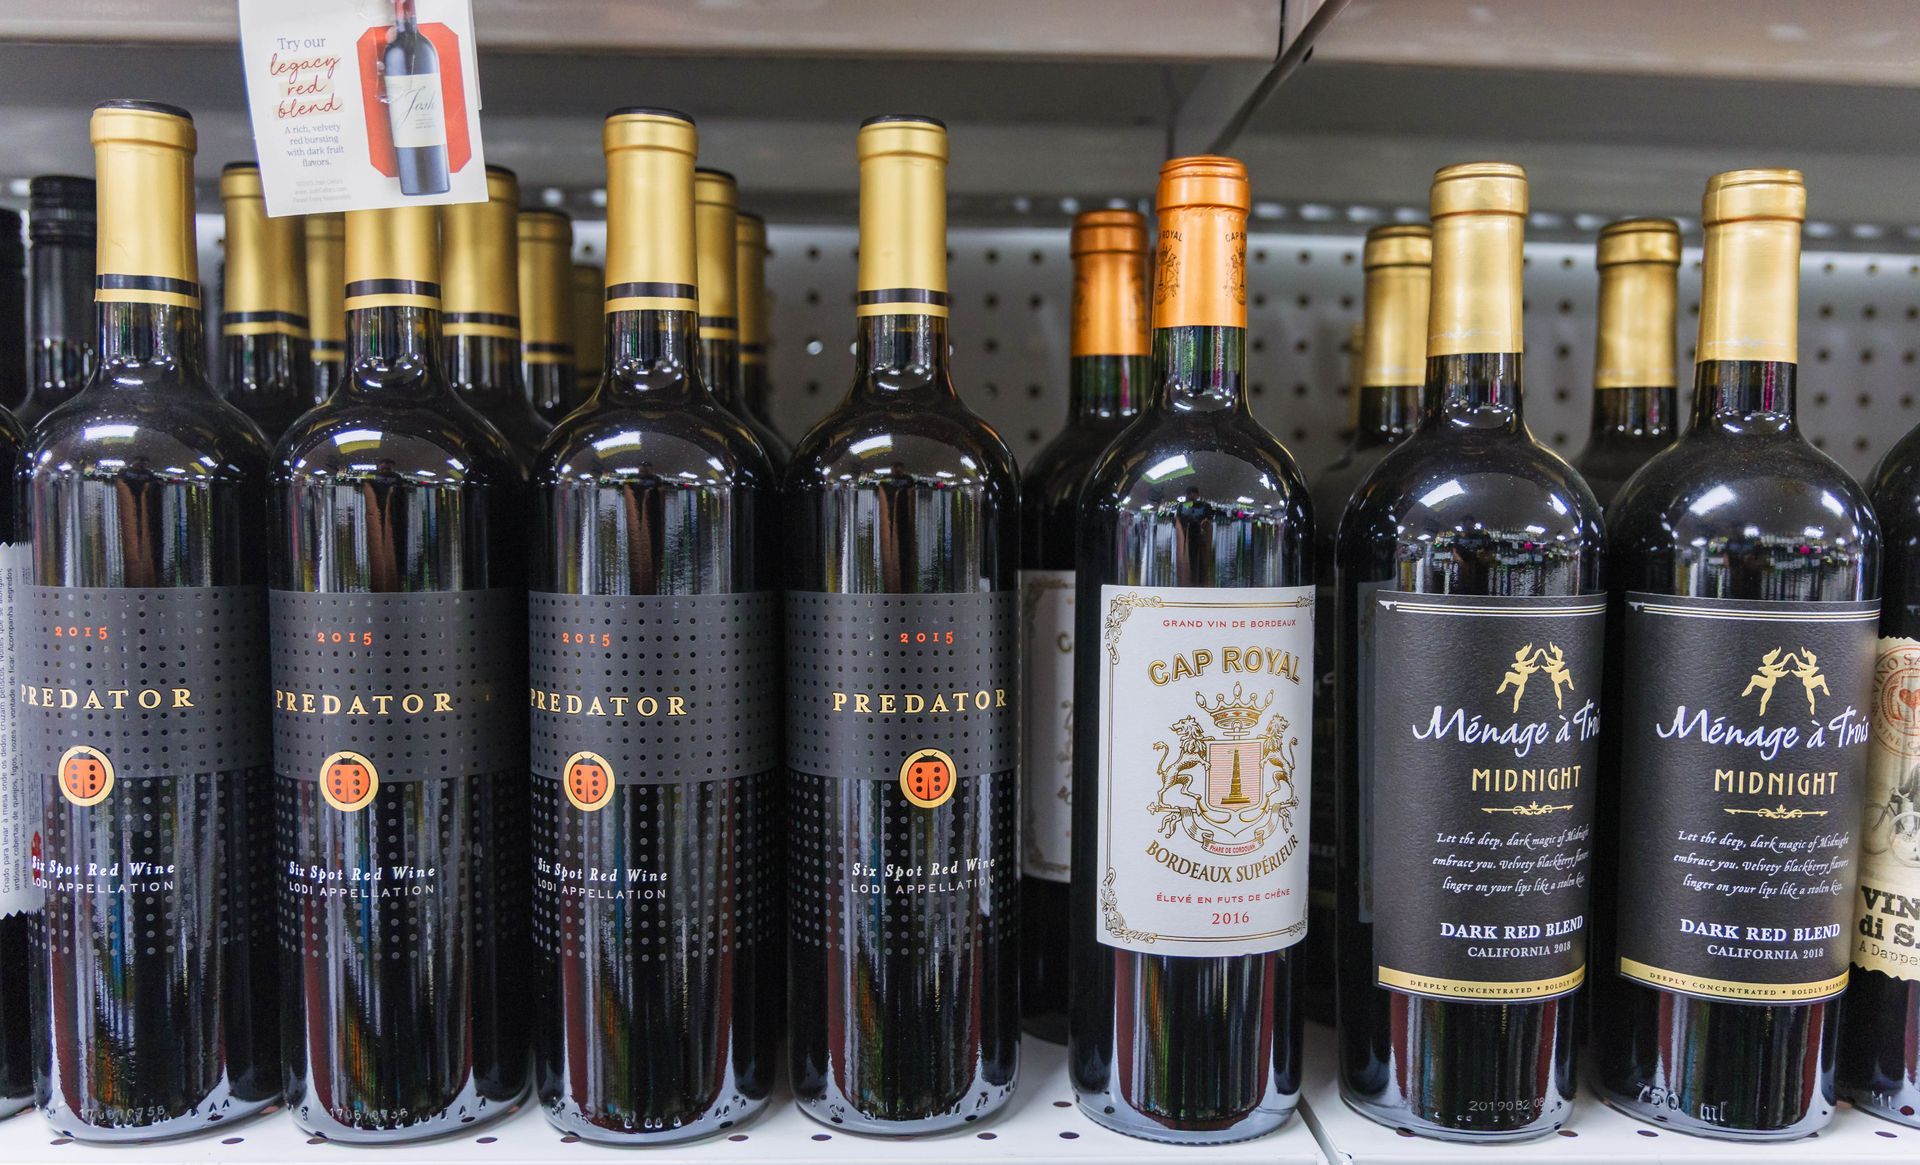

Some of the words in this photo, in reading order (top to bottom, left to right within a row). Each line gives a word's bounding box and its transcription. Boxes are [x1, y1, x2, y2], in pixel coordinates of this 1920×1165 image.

[277, 38, 300, 52] Try
[304, 38, 326, 49] our
[270, 53, 342, 84] legacy
[288, 74, 327, 96] red
[278, 93, 343, 118] blend
[284, 126, 291, 135] A
[293, 125, 311, 134] rich,
[312, 123, 341, 134] velvety
[290, 137, 303, 145] red
[305, 135, 339, 146] bursting
[287, 148, 305, 157] with
[307, 147, 325, 156] dark
[326, 146, 344, 154] fruit
[302, 159, 331, 167] flavors.
[6, 567, 15, 603] segredos
[7, 606, 15, 652] Acompanha
[54, 626, 109, 641] 2015
[1163, 619, 1203, 628] GRAND
[1208, 620, 1227, 628] VIN
[1232, 620, 1246, 628] DE
[1251, 619, 1296, 628] BORDEAUX
[317, 632, 372, 646] 2015
[562, 632, 611, 647] 2015
[900, 631, 954, 644] 2015
[1148, 647, 1213, 686] CAP
[1222, 645, 1301, 685] ROYAL
[21, 683, 194, 710] PREDATOR
[275, 689, 453, 715] PREDATOR
[530, 687, 687, 717] PREDATOR
[832, 688, 1007, 714] PREDATOR
[1412, 705, 1549, 758] Ménage
[1555, 714, 1571, 743] à
[1656, 705, 1800, 762] Ménage
[1806, 719, 1825, 749] à
[1828, 705, 1869, 748] Trois
[1472, 765, 1581, 792] MIDNIGHT
[1714, 769, 1838, 796] MIDNIGHT
[1436, 832, 1455, 844] Let
[1459, 831, 1474, 845] the
[1478, 832, 1503, 850] deep,
[1506, 832, 1536, 850] dark
[1532, 835, 1556, 848] magic
[1557, 829, 1567, 848] of
[1678, 830, 1698, 842] Let
[1700, 831, 1716, 844] the
[1719, 833, 1747, 850] deep,
[1750, 834, 1783, 854] dark
[1778, 839, 1806, 852] magic
[1807, 835, 1820, 853] of
[32, 855, 45, 872] Six
[49, 859, 80, 878] Spot
[88, 862, 119, 876] Red
[129, 861, 176, 876] Wine
[537, 857, 551, 872] Six
[554, 863, 582, 880] Spot
[590, 867, 618, 882] Red
[627, 868, 668, 882] Wine
[852, 862, 876, 877] Six
[885, 865, 922, 881] Spot
[931, 861, 959, 875] Red
[966, 857, 996, 873] Wine
[1145, 840, 1233, 883] BORDEAUX
[1236, 833, 1299, 882] SUPÉRIEUR
[1432, 854, 1474, 868] embrace
[1470, 860, 1496, 873] you.
[1499, 856, 1535, 873] Velvety
[1673, 852, 1715, 867] embrace
[1717, 860, 1739, 872] you.
[1742, 858, 1782, 876] Velvety
[1784, 859, 1829, 876] blackberry
[289, 861, 305, 877] Six
[310, 865, 343, 882] Spot
[351, 867, 382, 881] Red
[392, 866, 435, 880] Wine
[32, 875, 51, 890] LODI
[57, 880, 174, 894] APPELLATION
[289, 881, 314, 895] LODI
[320, 884, 434, 898] APPELLATION
[538, 878, 557, 893] LODI
[561, 886, 666, 900] APPELLATION
[851, 883, 887, 894] LODI
[895, 875, 995, 894] APPELLATION
[1156, 892, 1192, 904] ÉLEVÉ
[1197, 896, 1212, 904] EN
[1217, 895, 1244, 904] FUTS
[1248, 893, 1261, 902] DE
[1264, 888, 1291, 900] CHÊNE
[1442, 876, 1473, 893] linger
[1475, 883, 1487, 891] on
[1484, 882, 1513, 896] your
[1514, 878, 1532, 897] lips
[1533, 877, 1551, 895] like
[1682, 873, 1714, 891] linger
[1716, 883, 1729, 891] on
[1726, 884, 1756, 896] your
[1758, 881, 1778, 898] lips
[1780, 882, 1800, 899] like
[1807, 880, 1829, 894] stolen
[1211, 911, 1250, 925] 2016
[1440, 922, 1498, 940] DARK
[1503, 925, 1541, 940] RED
[1545, 915, 1583, 937] BLEND
[1679, 918, 1740, 940] DARK
[1746, 927, 1787, 942] RED
[1792, 923, 1841, 942] BLEND
[1859, 913, 1884, 941] di
[1893, 922, 1920, 949] S
[1467, 946, 1551, 958] CALIFORNIA
[1554, 941, 1571, 954] 2018
[1707, 944, 1799, 960] CALIFORNIA
[1803, 947, 1824, 960] 2018
[1859, 940, 1867, 952] A
[1871, 943, 1920, 966] Dappe
[1410, 979, 1448, 991] DEEPLY
[1453, 986, 1532, 994] CONCENTRATED
[1650, 972, 1686, 986] DEEPLY
[1692, 982, 1776, 996] CONCENTRATED
[1791, 986, 1822, 996] BOLDLY
